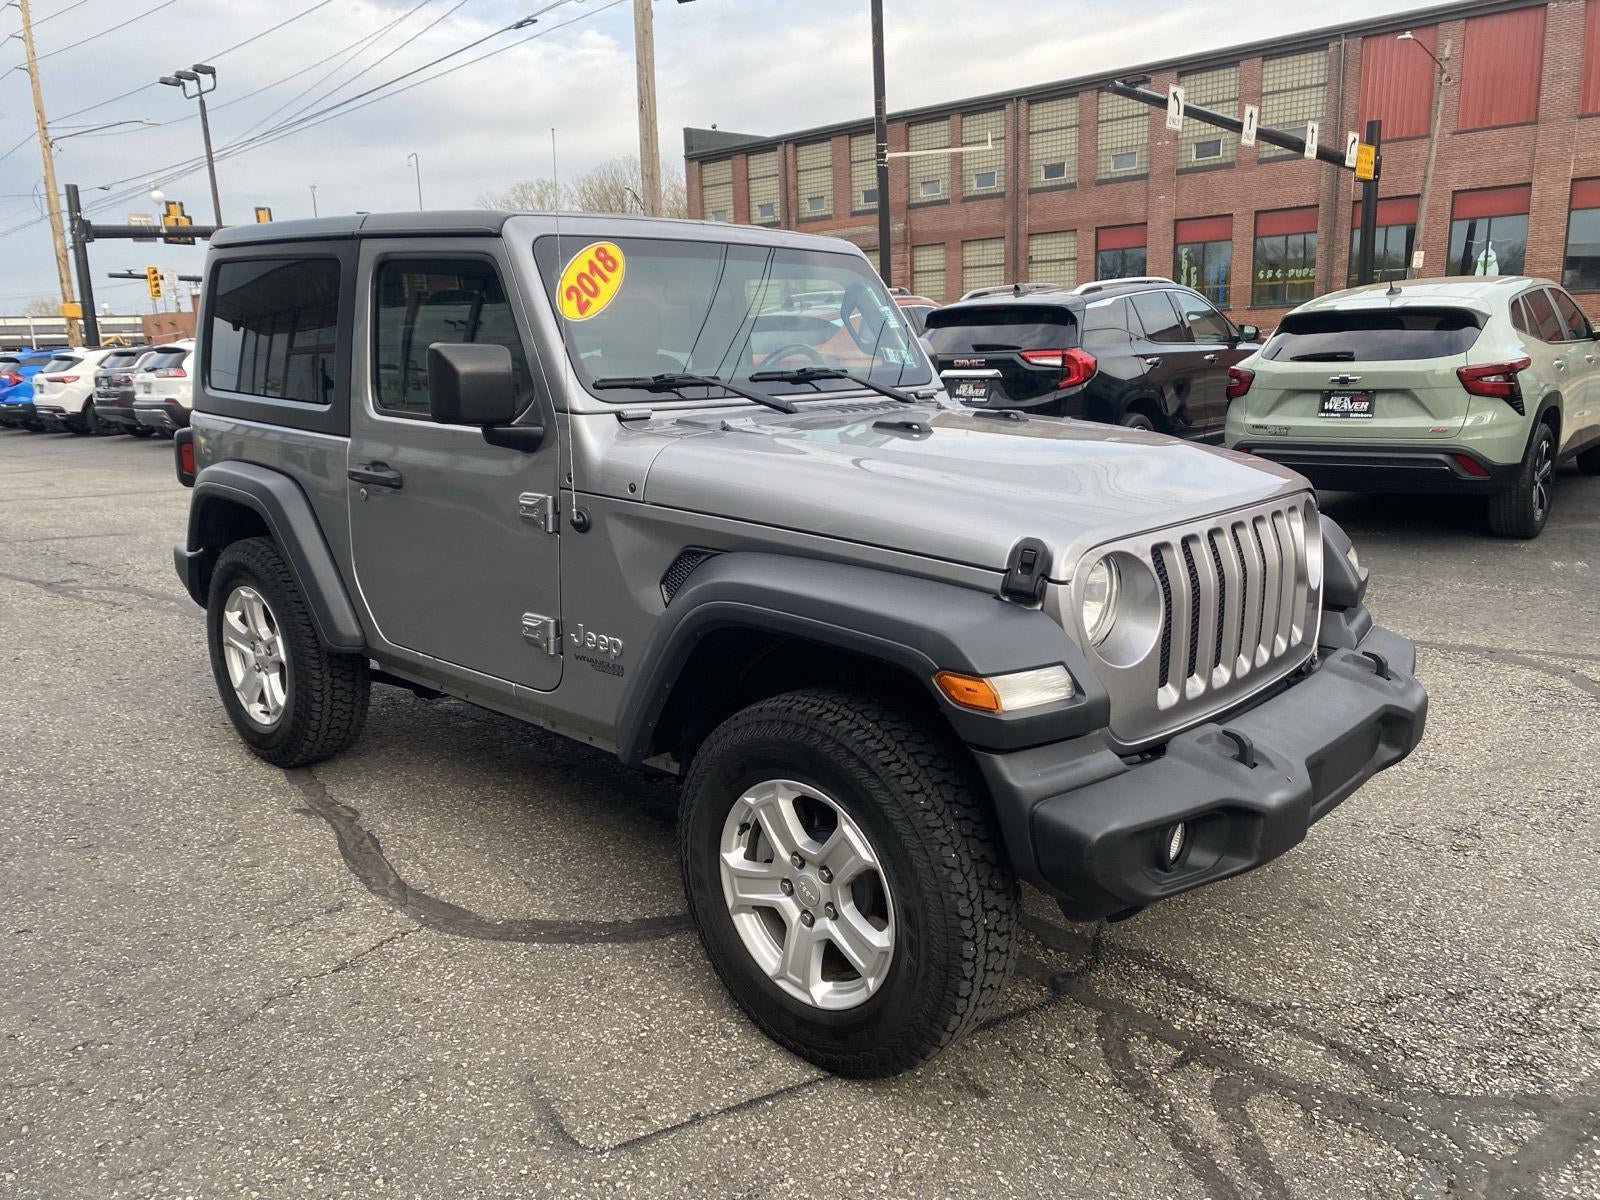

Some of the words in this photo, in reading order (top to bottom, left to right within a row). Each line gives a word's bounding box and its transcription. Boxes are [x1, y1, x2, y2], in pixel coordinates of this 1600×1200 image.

[565, 246, 619, 316] 2018
[953, 359, 986, 367] GMC
[1324, 401, 1370, 410] WEAVER
[570, 623, 623, 661] Jeep
[574, 652, 624, 672] WRANGLER
